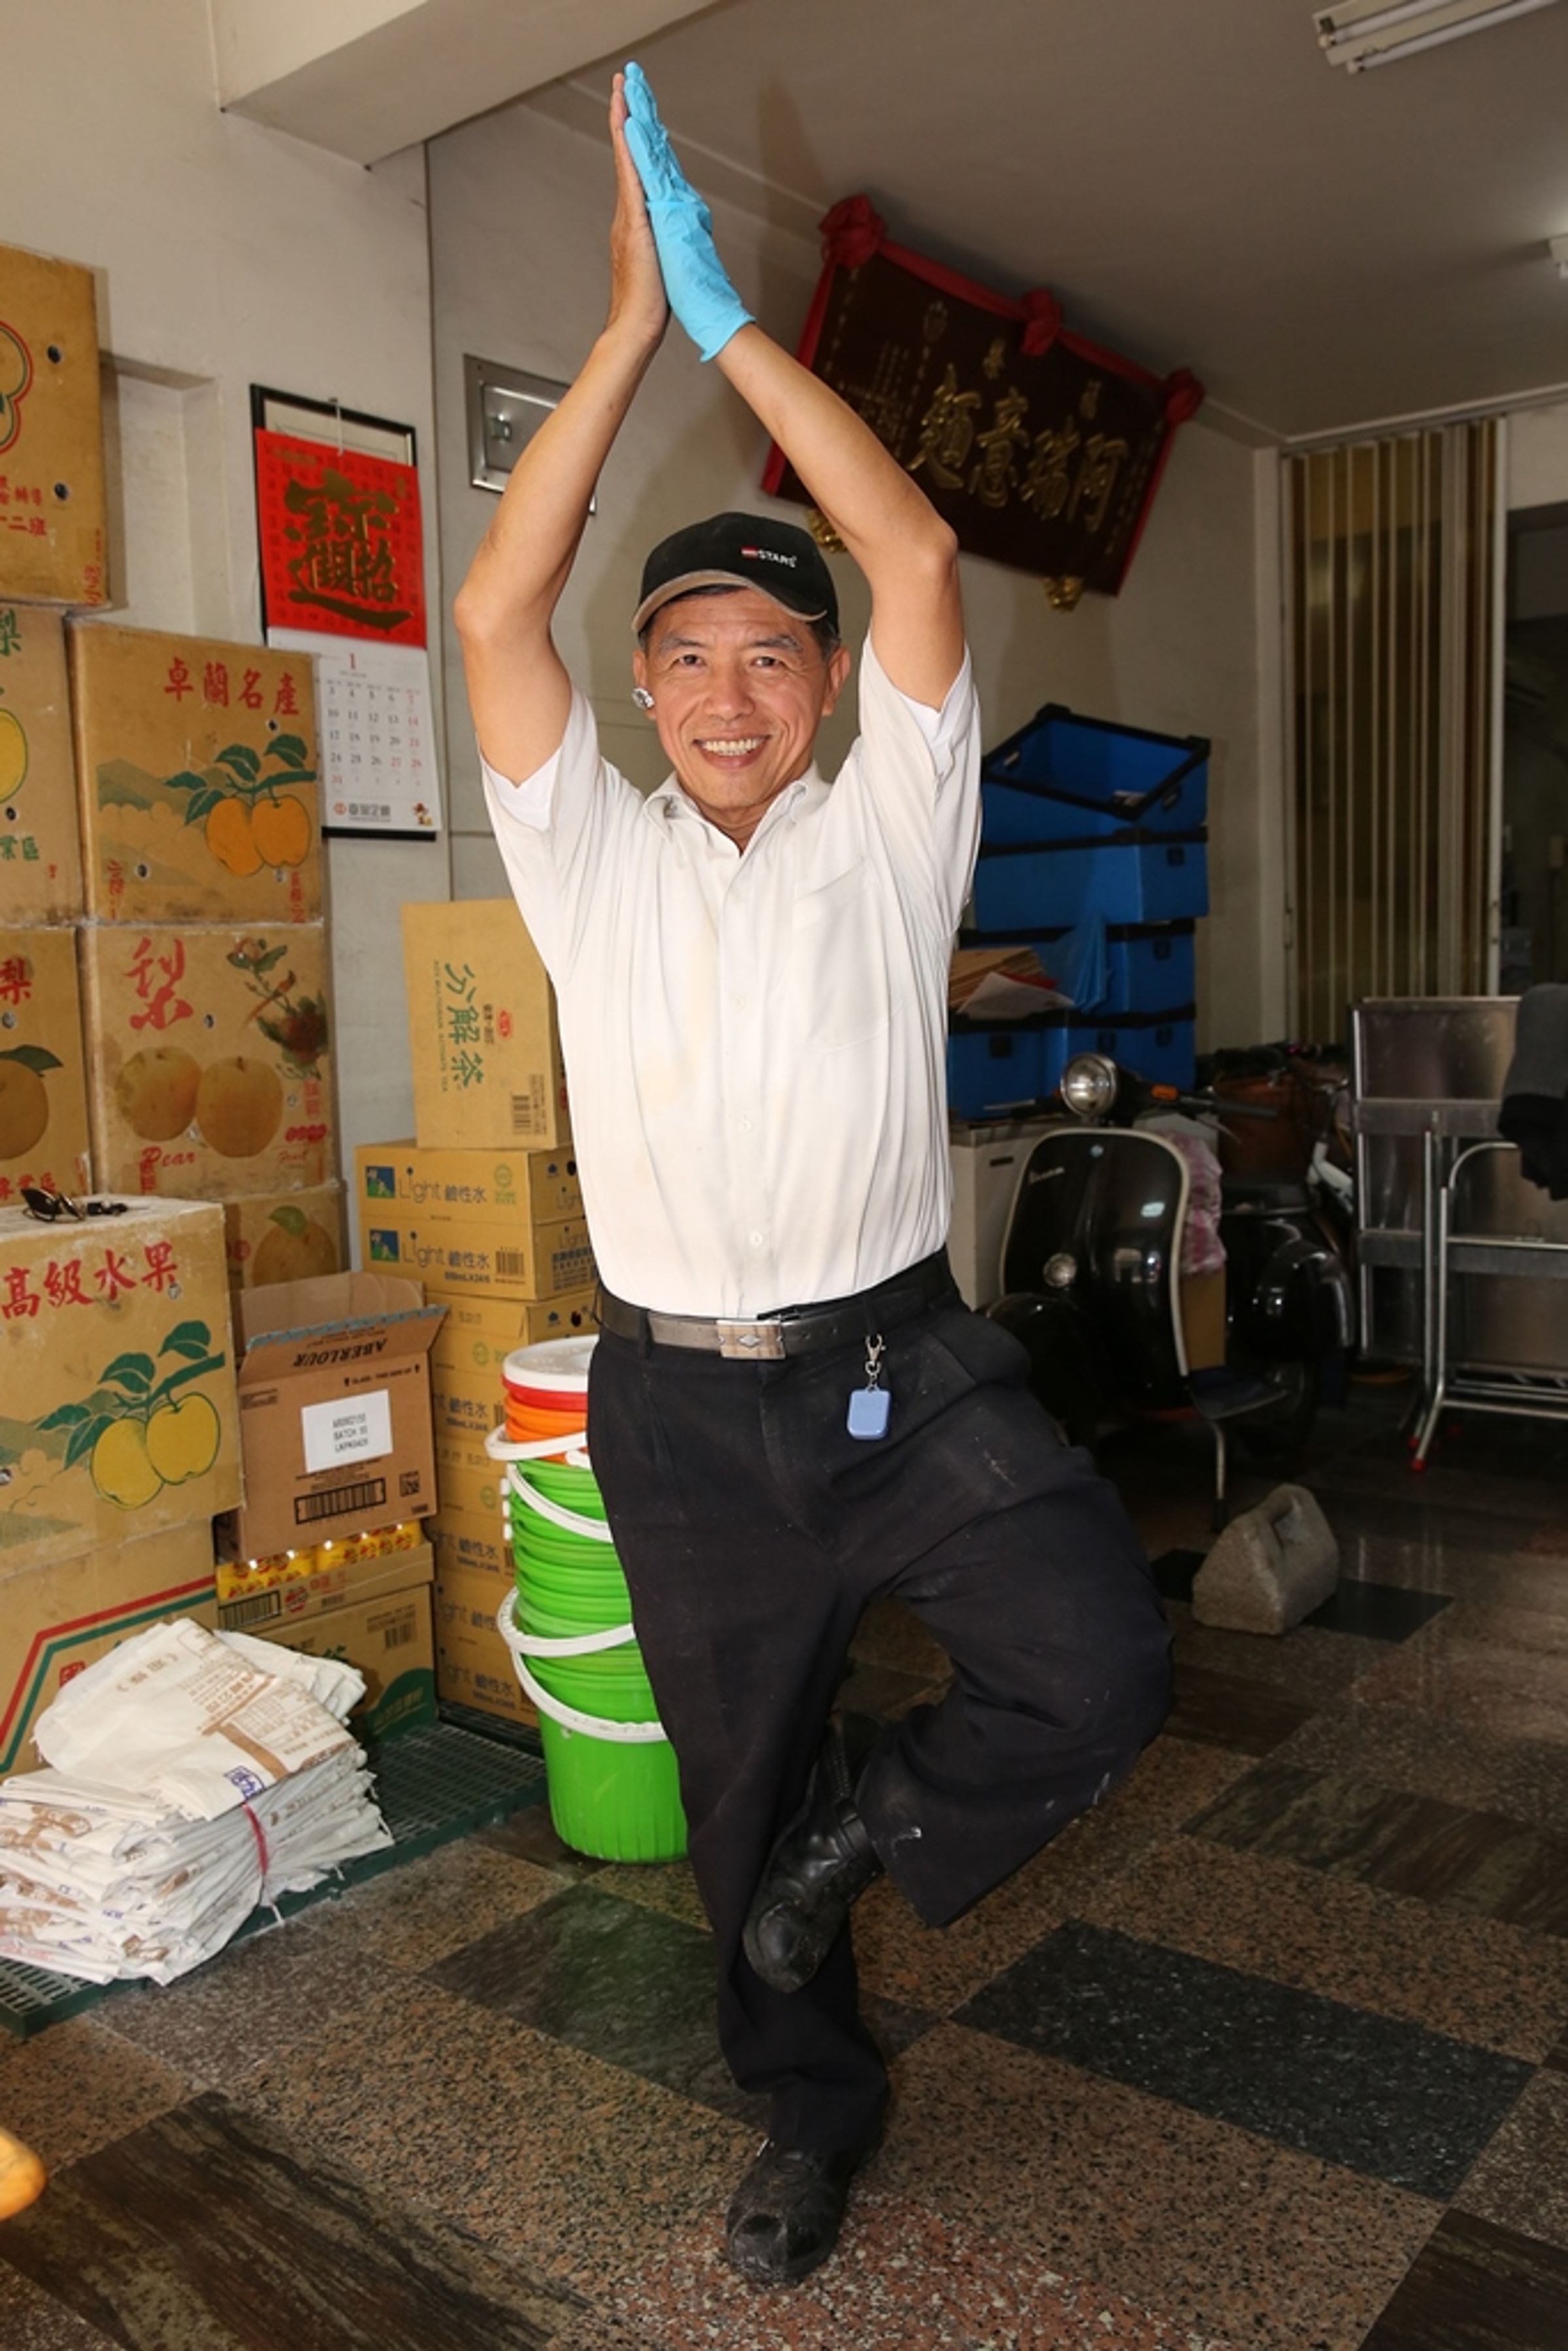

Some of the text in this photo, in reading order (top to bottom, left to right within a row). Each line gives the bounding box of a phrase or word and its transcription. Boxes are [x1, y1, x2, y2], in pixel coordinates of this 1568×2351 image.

[164, 657, 301, 716] 卓蘭名產
[445, 962, 483, 1087] 分解茶
[399, 1166, 441, 1204] Light
[403, 1231, 446, 1268] Light
[2, 1241, 179, 1320] 高級水果
[293, 1338, 389, 1367] ABERLOUR
